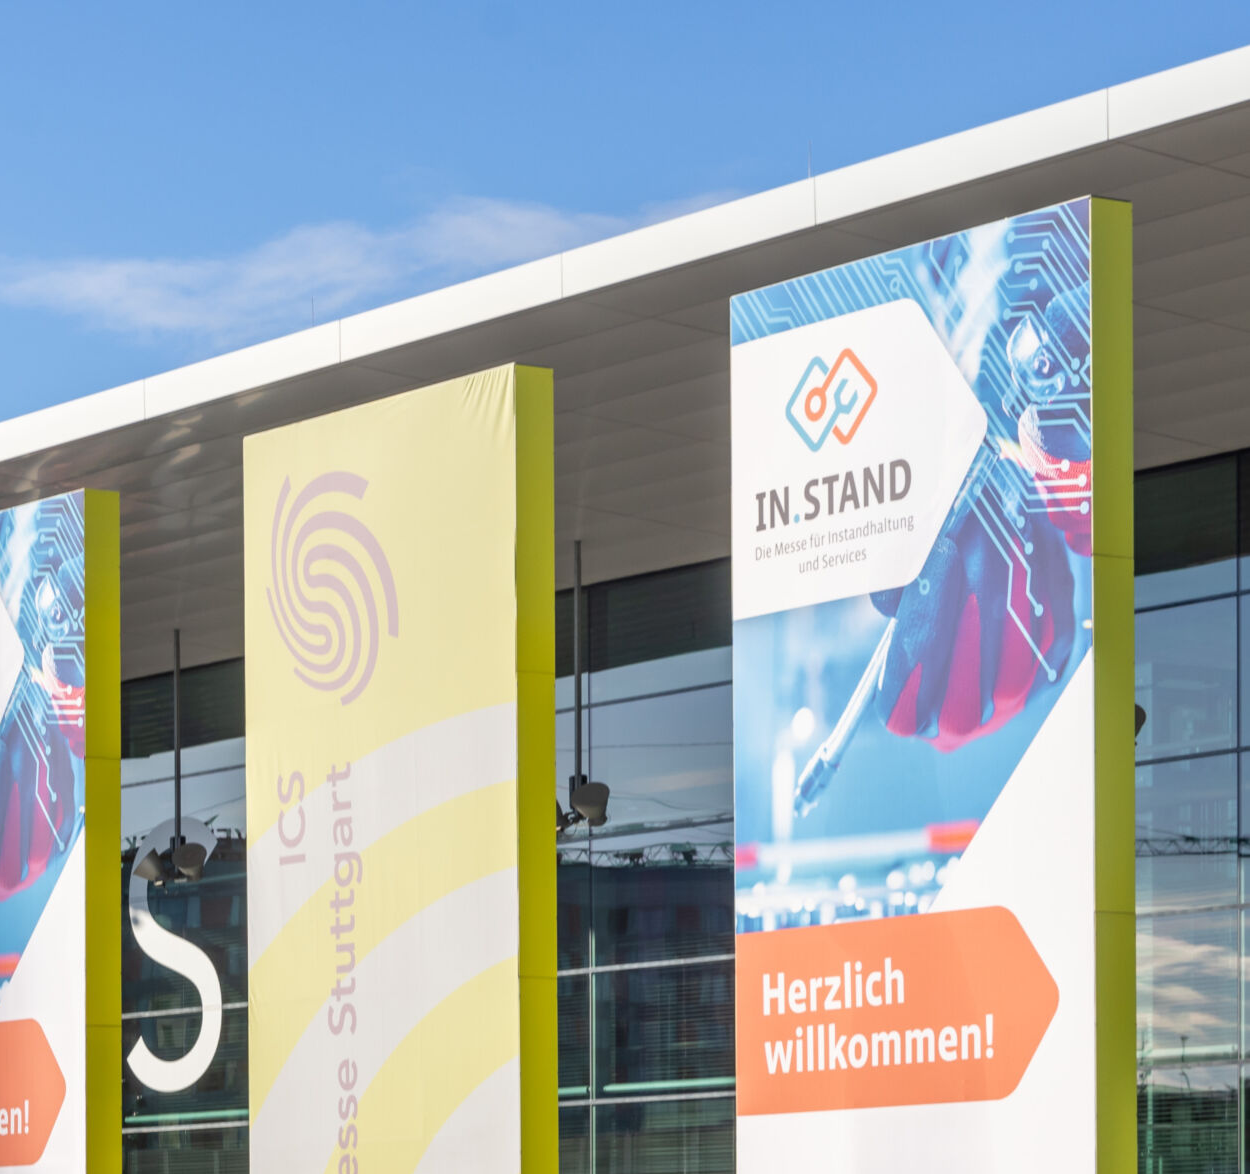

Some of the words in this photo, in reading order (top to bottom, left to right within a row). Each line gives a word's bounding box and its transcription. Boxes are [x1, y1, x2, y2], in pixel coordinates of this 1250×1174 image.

[755, 459, 912, 532] IN.STAND
[755, 546, 772, 561] Die
[775, 539, 807, 557] Messe
[810, 533, 826, 549] für
[828, 515, 914, 544] Instandhaltung
[799, 556, 819, 574] und
[822, 548, 867, 569] Services
[277, 770, 306, 865] ICS
[327, 762, 363, 1035] Stuttgart
[763, 957, 905, 1016] Herzlich
[764, 1013, 994, 1075] willkommen!
